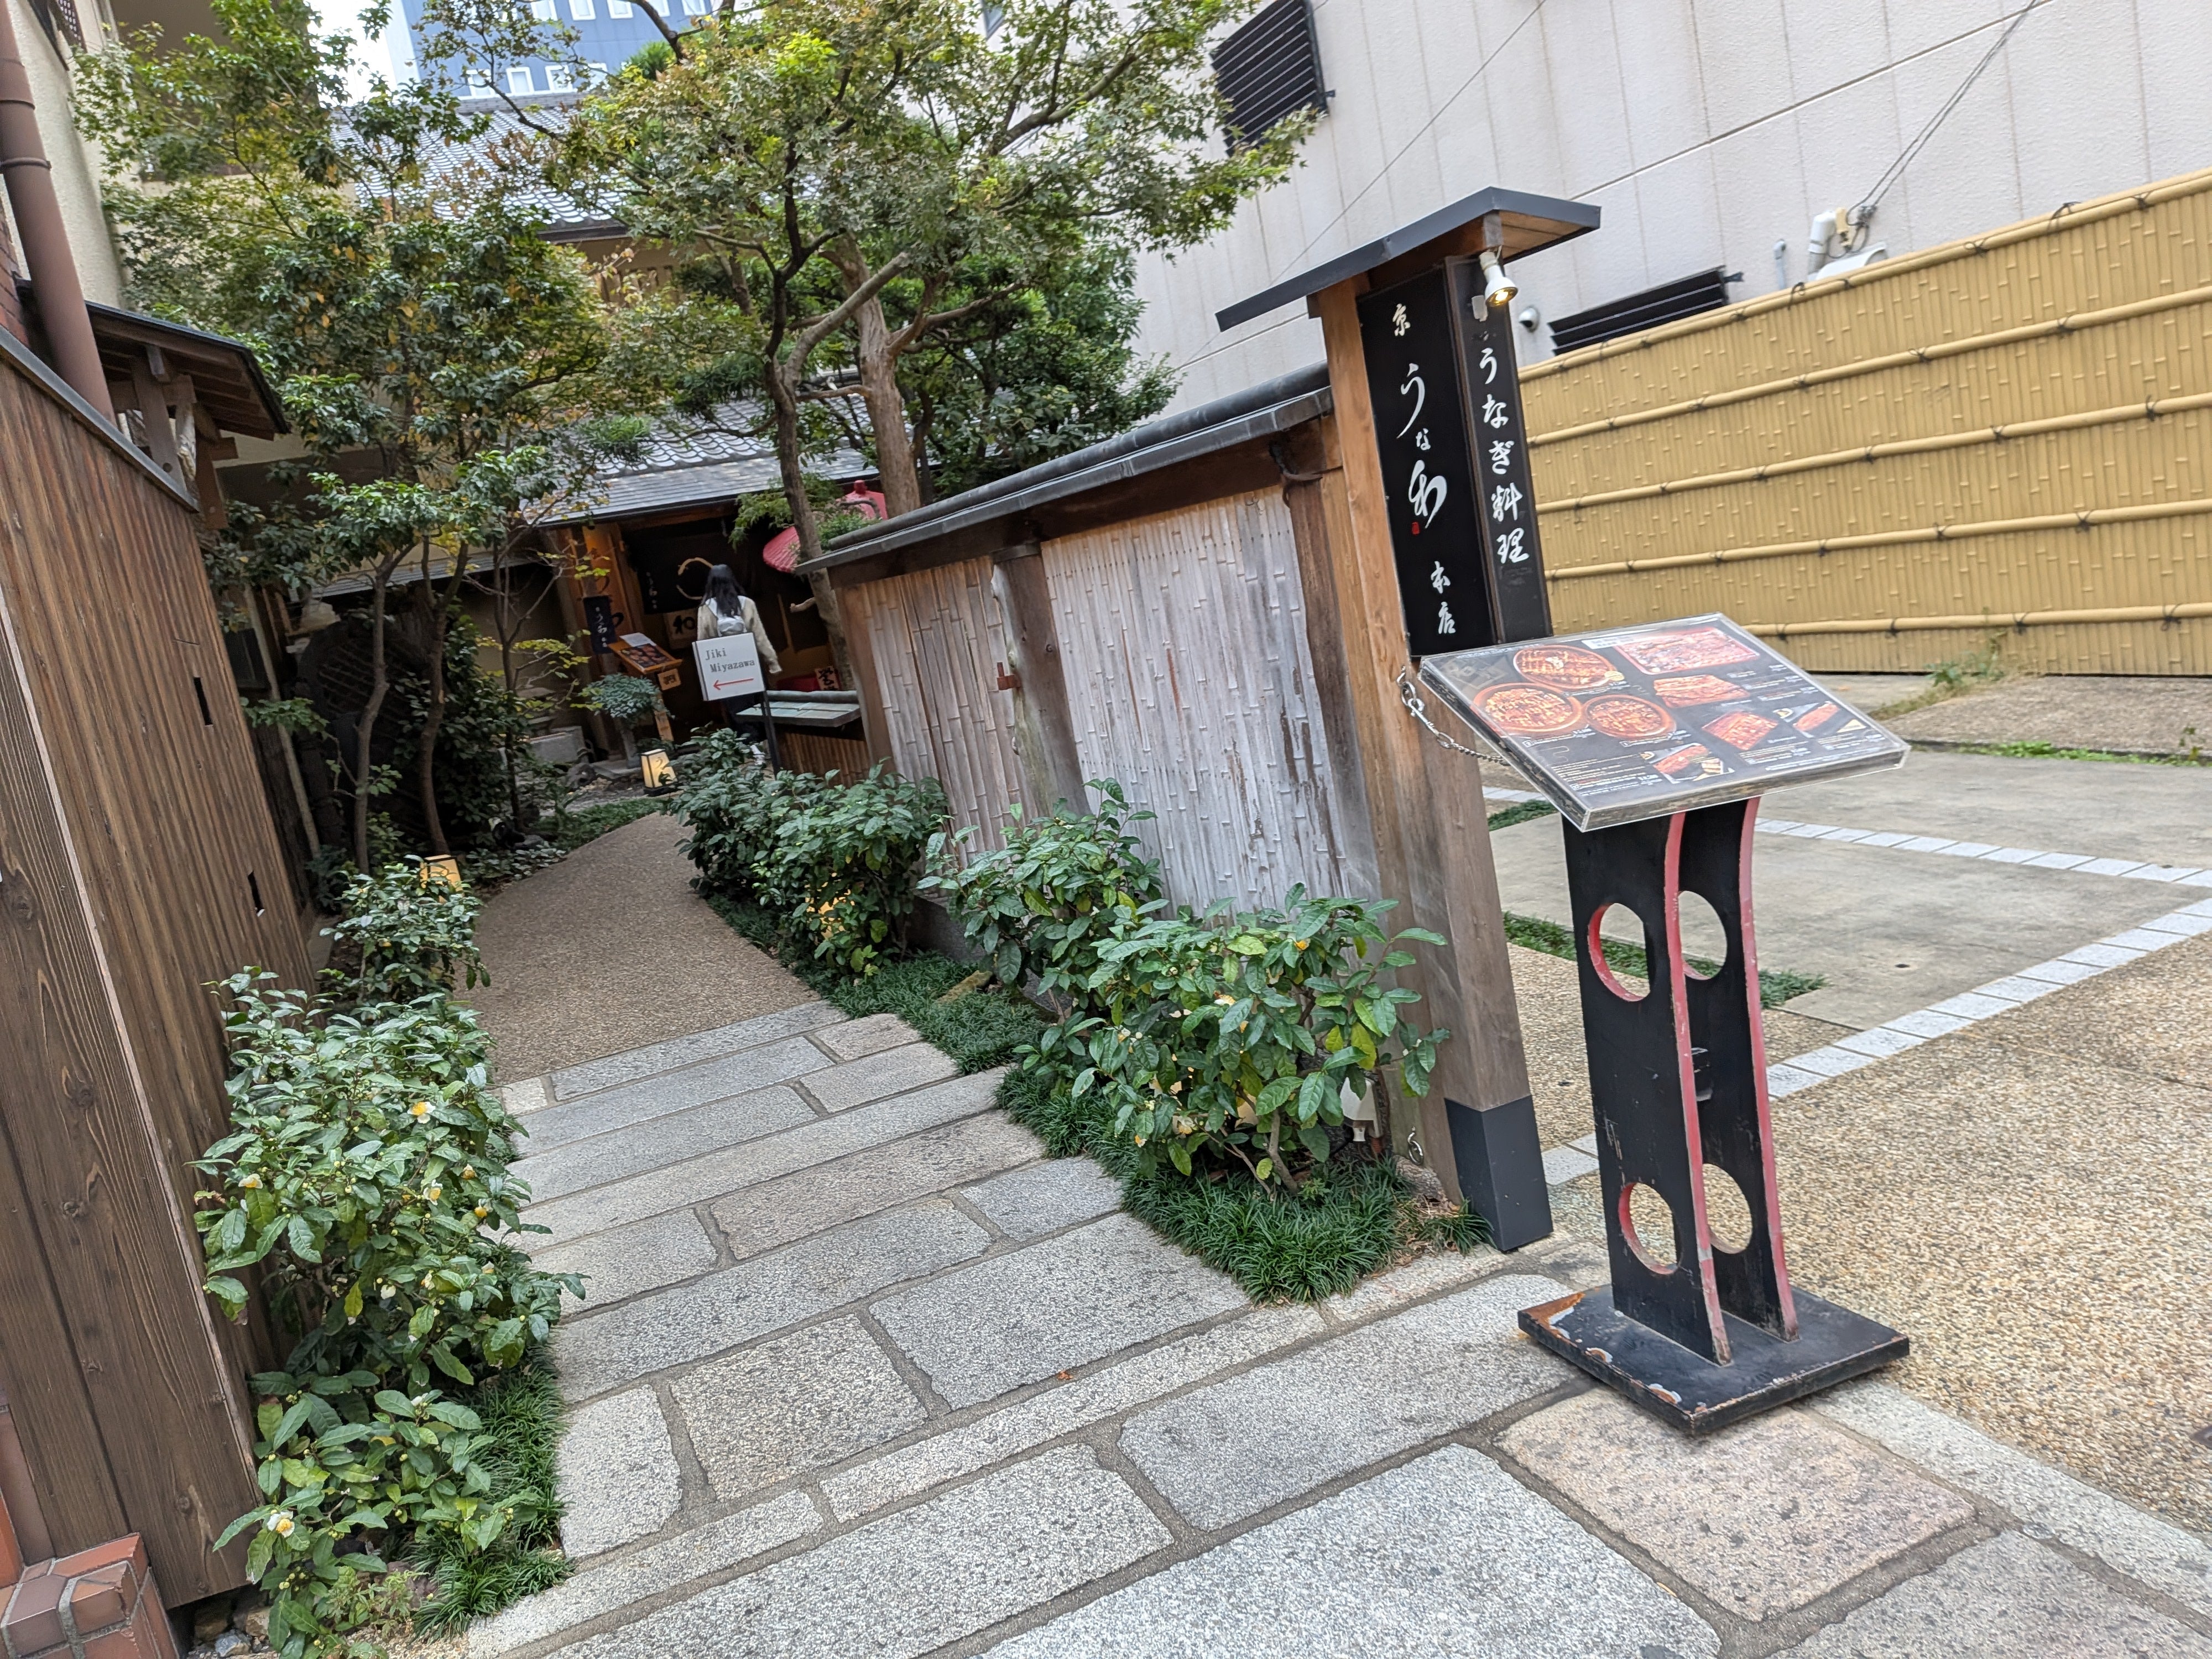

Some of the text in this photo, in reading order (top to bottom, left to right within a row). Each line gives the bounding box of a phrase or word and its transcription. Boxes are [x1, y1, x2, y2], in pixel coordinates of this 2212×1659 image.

[1479, 348, 1530, 564] うなぎ料理
[1431, 561, 1456, 634] 本店
[705, 648, 727, 660] Jiki
[710, 660, 755, 672] Miyazawa
